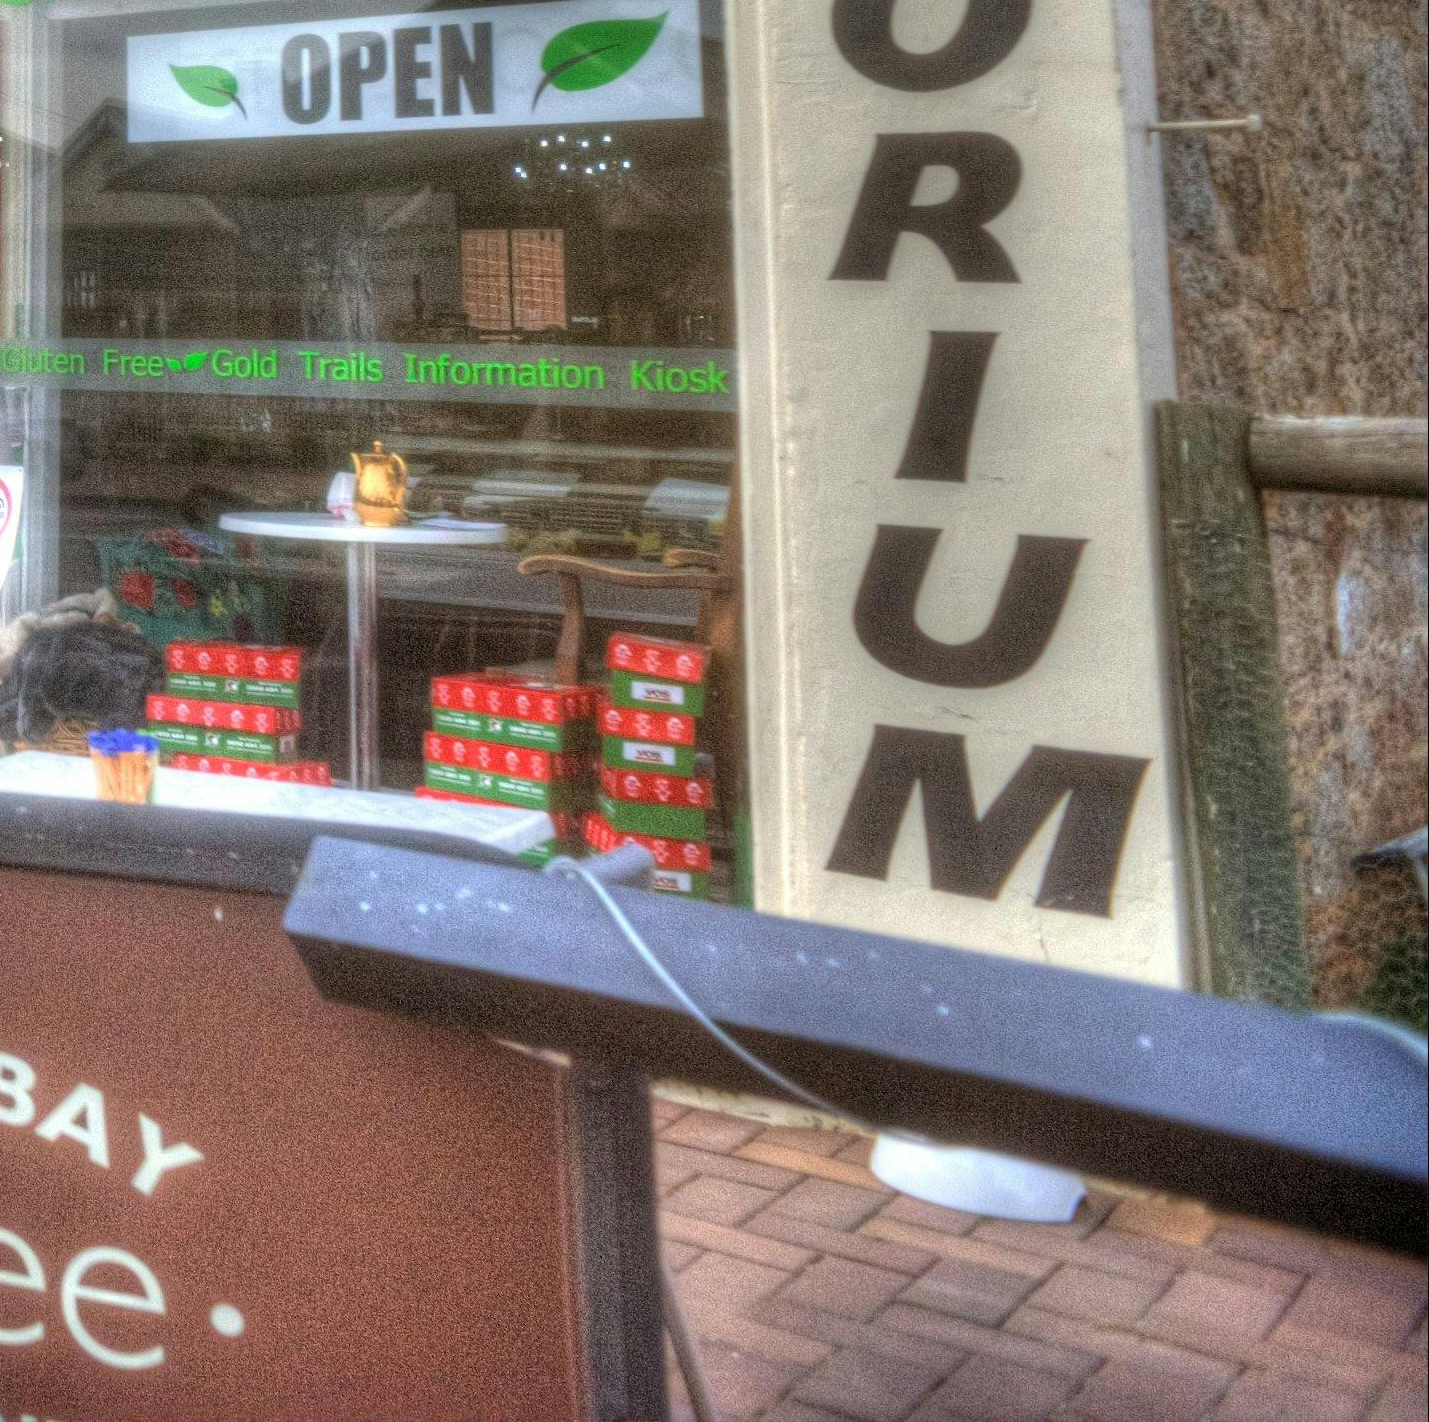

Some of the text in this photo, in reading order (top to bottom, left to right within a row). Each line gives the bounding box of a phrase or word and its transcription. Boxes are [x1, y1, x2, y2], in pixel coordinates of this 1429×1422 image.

[281, 21, 497, 125] OPEN
[102, 348, 165, 377] Free
[210, 349, 278, 379] Gold
[298, 350, 383, 383] Trails
[406, 353, 605, 391] Information
[629, 359, 730, 395] Kiosk
